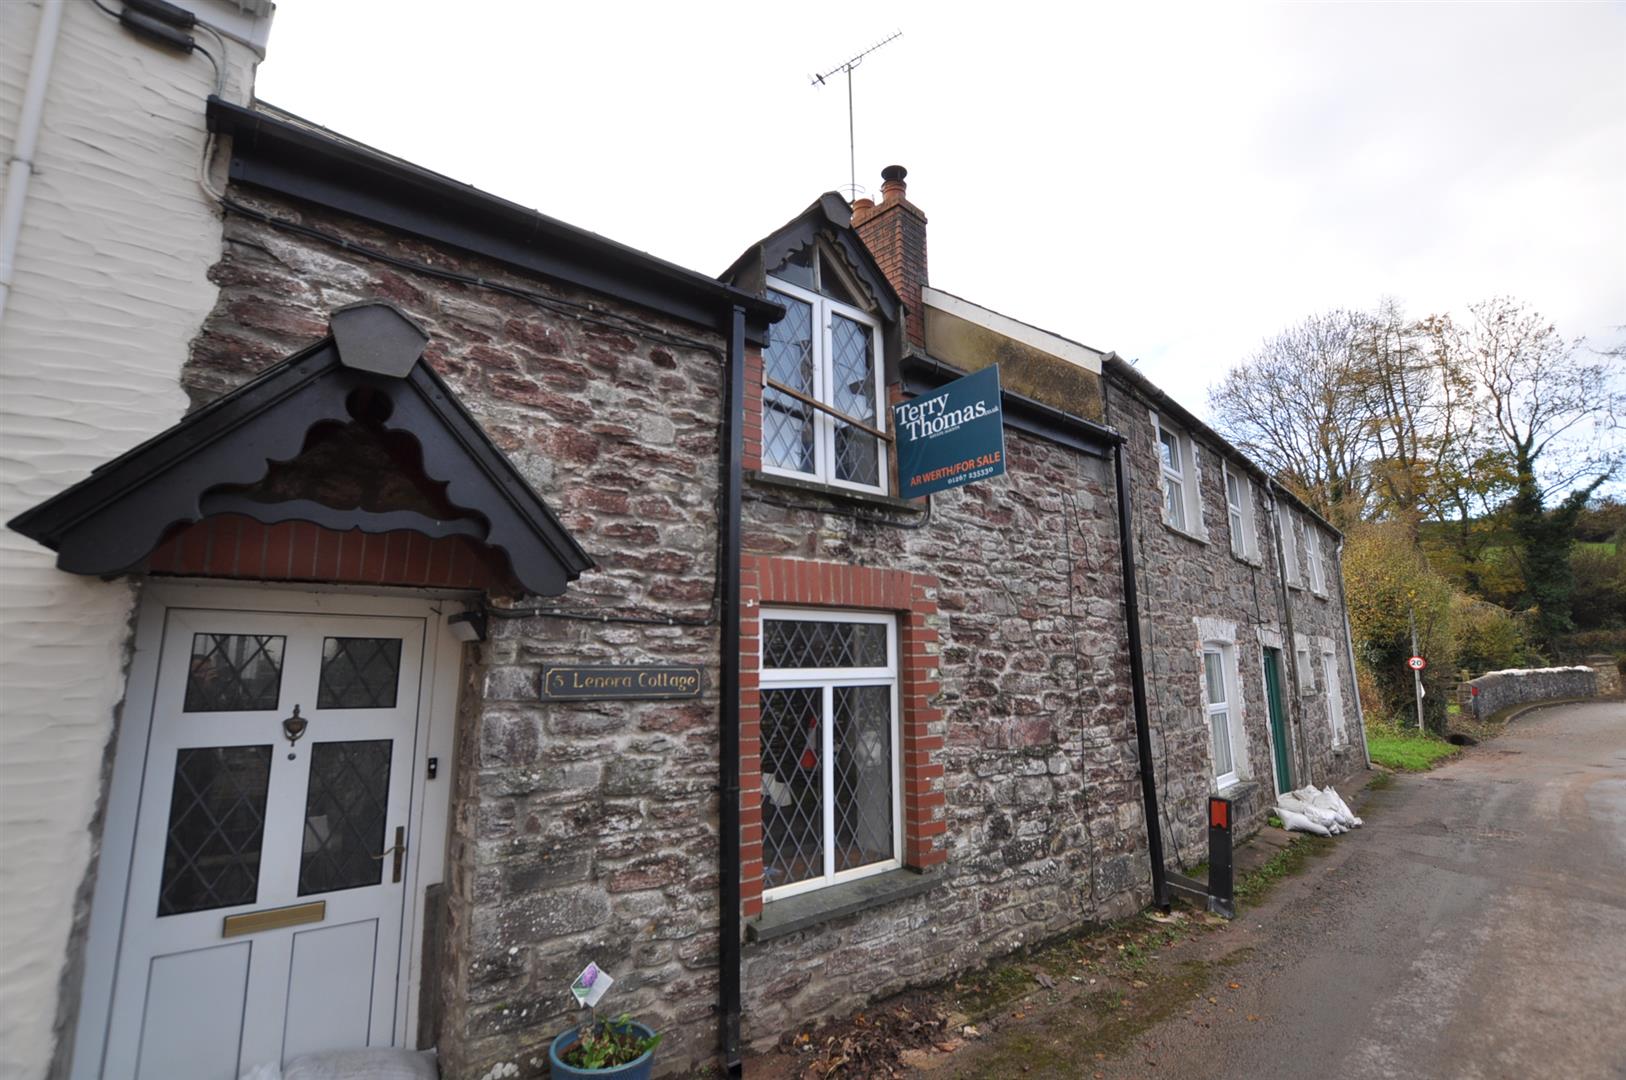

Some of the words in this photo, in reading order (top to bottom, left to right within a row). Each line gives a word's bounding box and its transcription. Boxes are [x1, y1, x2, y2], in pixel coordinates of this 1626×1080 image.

[896, 393, 949, 425] Terry
[906, 401, 985, 441] Thomas
[911, 475, 922, 486] AR
[976, 451, 1001, 467] SALE
[573, 672, 632, 689] Lenora
